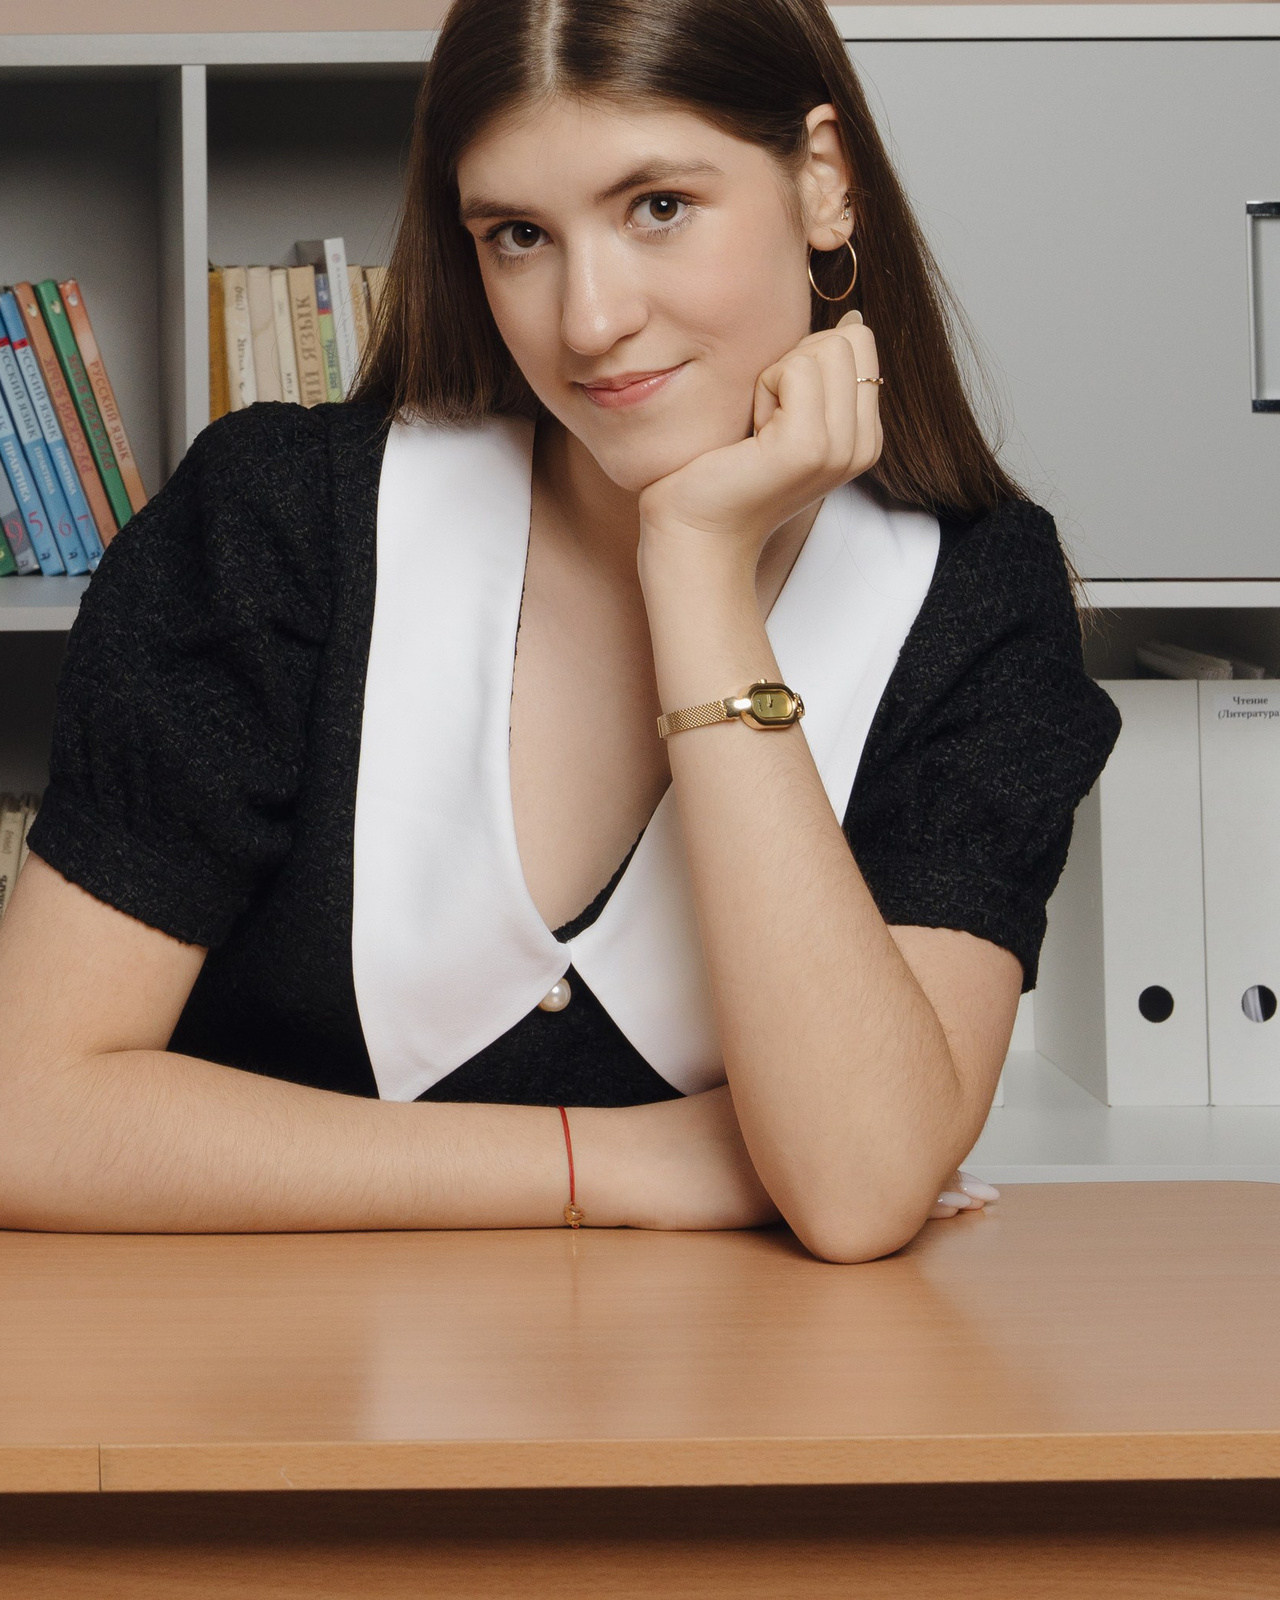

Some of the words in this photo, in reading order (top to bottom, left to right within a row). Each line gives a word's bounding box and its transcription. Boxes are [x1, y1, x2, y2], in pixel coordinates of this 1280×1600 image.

[294, 294, 317, 361] ЯЗЫК
[41, 354, 66, 399] ЯЗЫК
[17, 401, 38, 439] ЯЗЫК
[38, 402, 59, 439] ЯЗЫК
[87, 359, 119, 422] РУССКИЙ
[109, 424, 131, 462] ЯЗЫК
[56, 400, 92, 475] РУССКИЙ
[79, 395, 116, 472] РУССКИЙ
[2, 439, 32, 503] ПРАКТИКА
[32, 445, 56, 495] ПРАКТИКА
[54, 445, 78, 496] ПРАКТИКА
[4, 519, 23, 551] 9
[28, 510, 43, 538] 5
[58, 512, 72, 538] 6
[77, 513, 90, 539] 7
[1217, 709, 1280, 720] (Литература
[1232, 696, 1269, 705] Чтение
